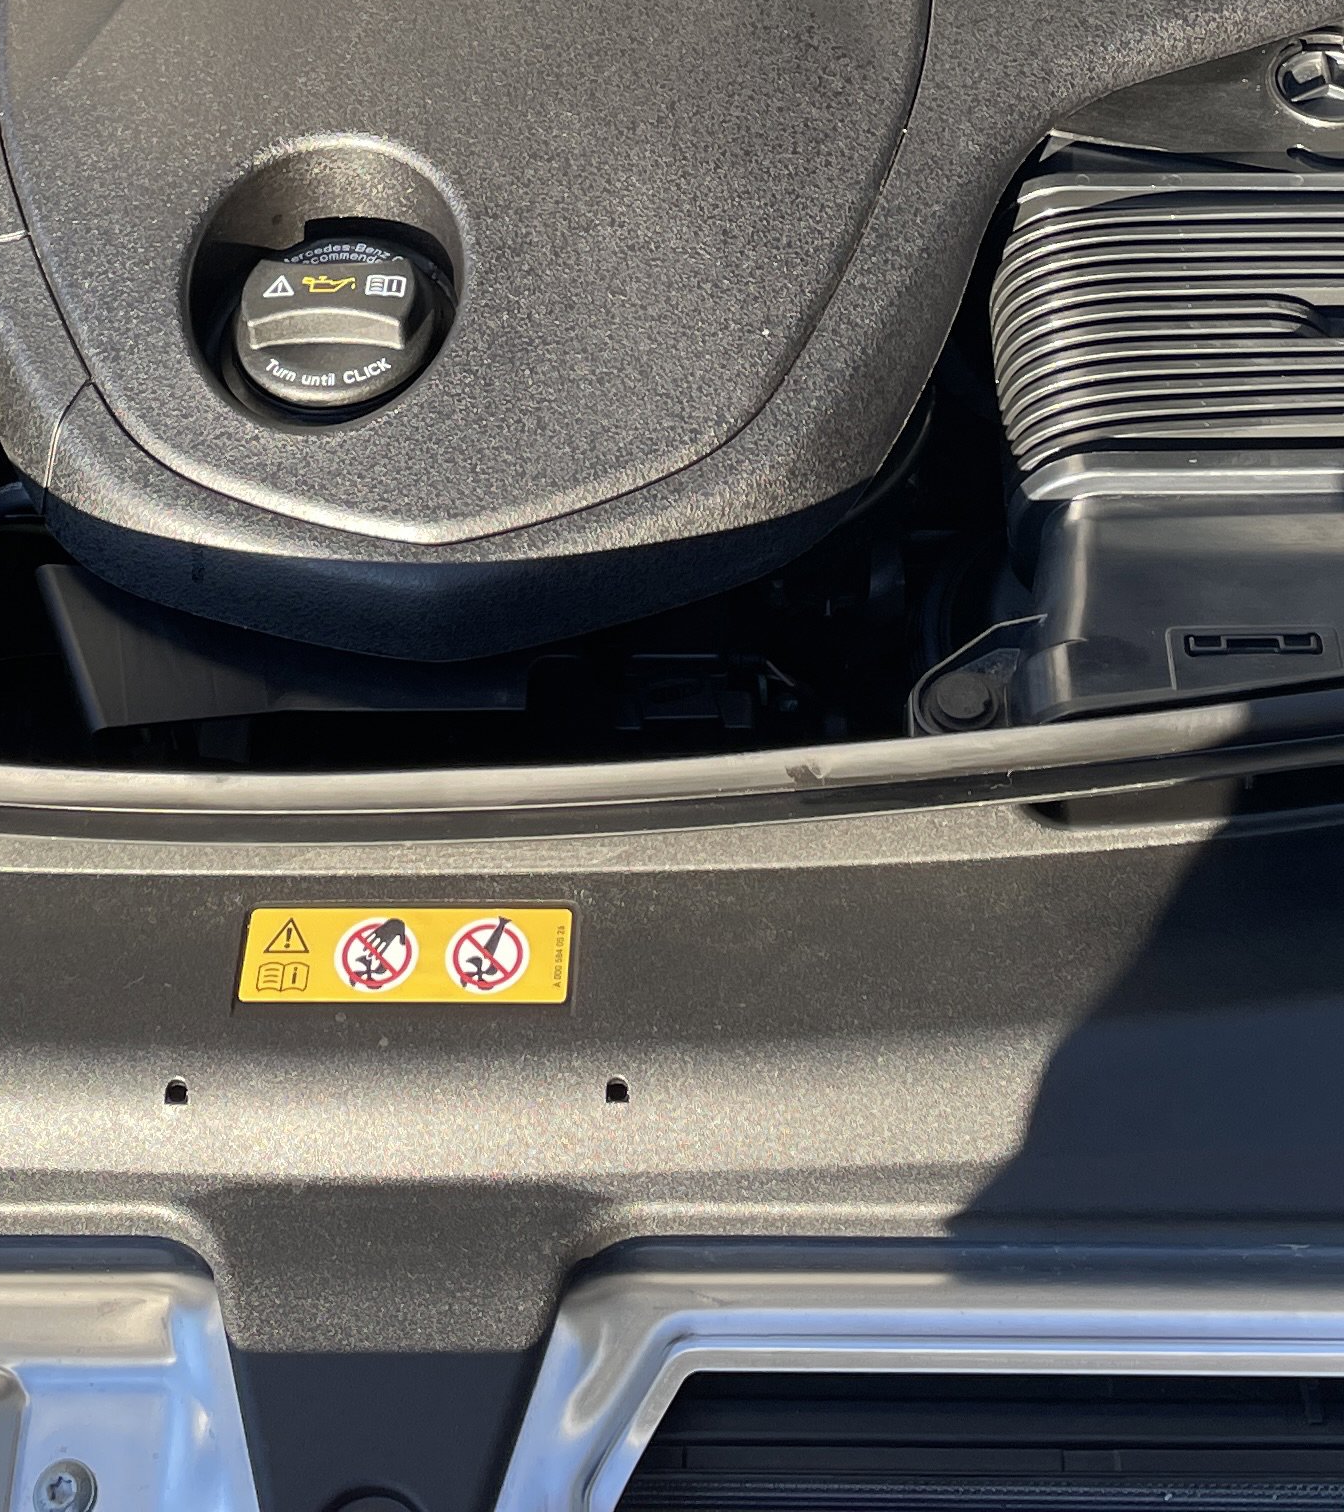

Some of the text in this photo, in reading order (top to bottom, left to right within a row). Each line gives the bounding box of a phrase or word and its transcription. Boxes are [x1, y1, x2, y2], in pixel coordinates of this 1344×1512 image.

[265, 358, 392, 386] Turn until CLICK
